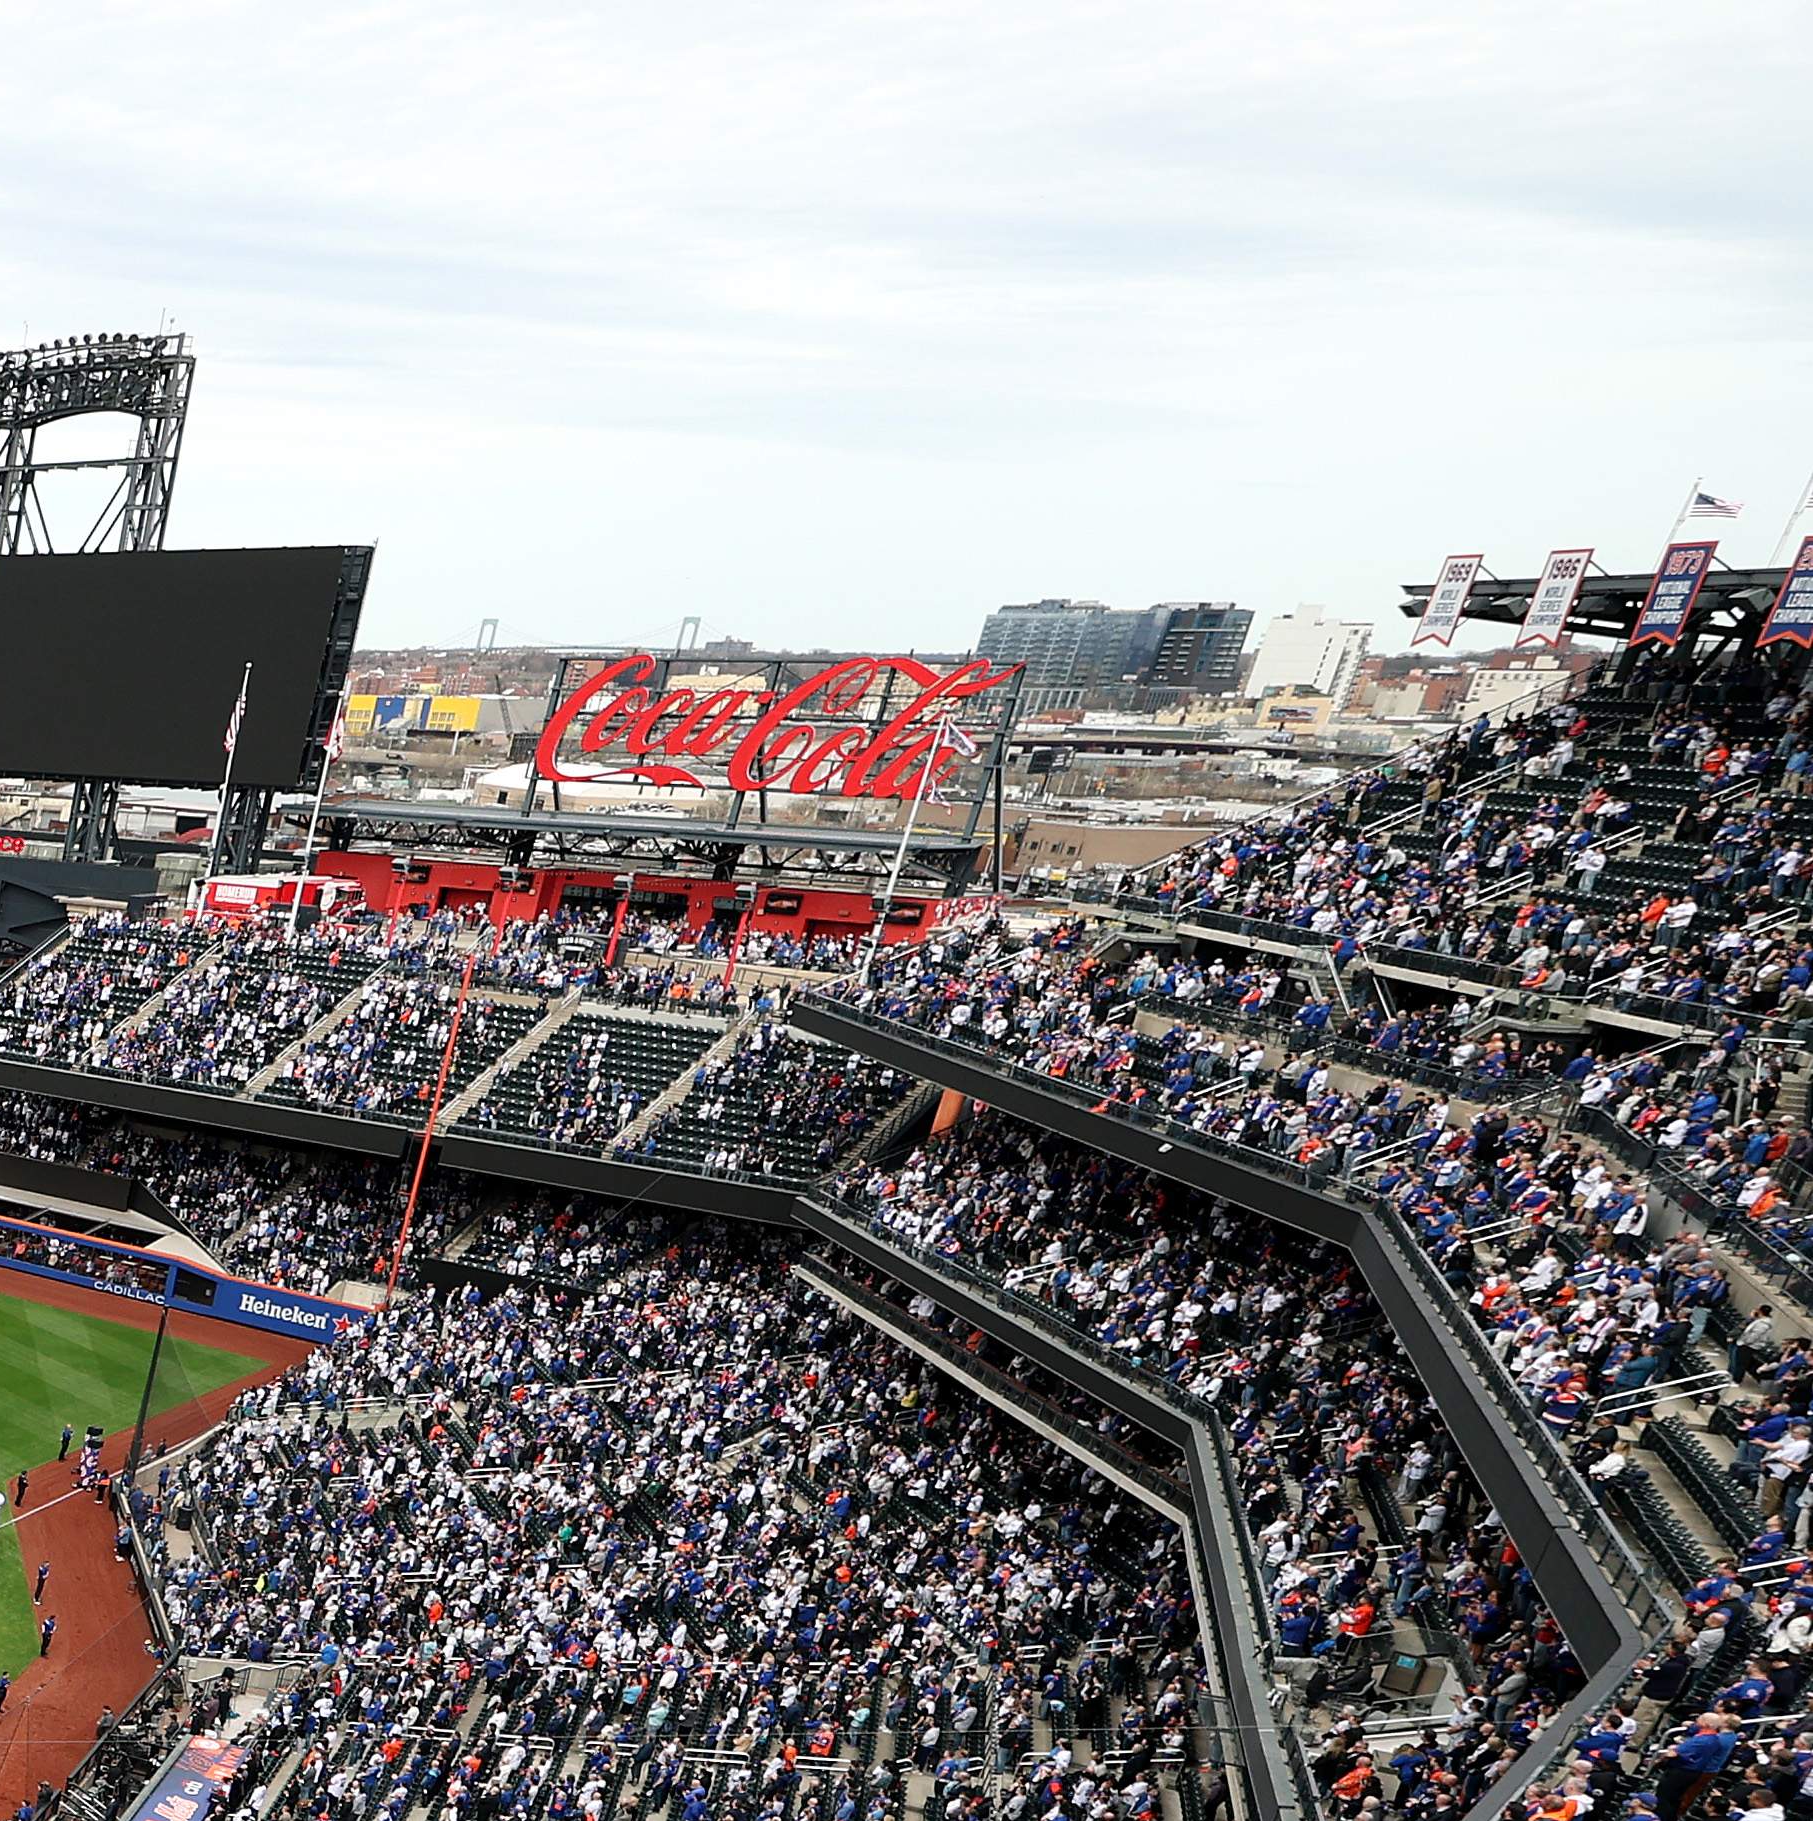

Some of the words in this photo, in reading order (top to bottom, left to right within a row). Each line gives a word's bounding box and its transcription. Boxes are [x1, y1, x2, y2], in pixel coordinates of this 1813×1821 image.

[1444, 563, 1473, 583] 1969
[1547, 557, 1581, 580] 1986
[1664, 550, 1705, 576] 1973
[535, 653, 1027, 799] Coca-Cola
[93, 1280, 166, 1306] CADILLAC
[238, 1293, 327, 1330] Heineken
